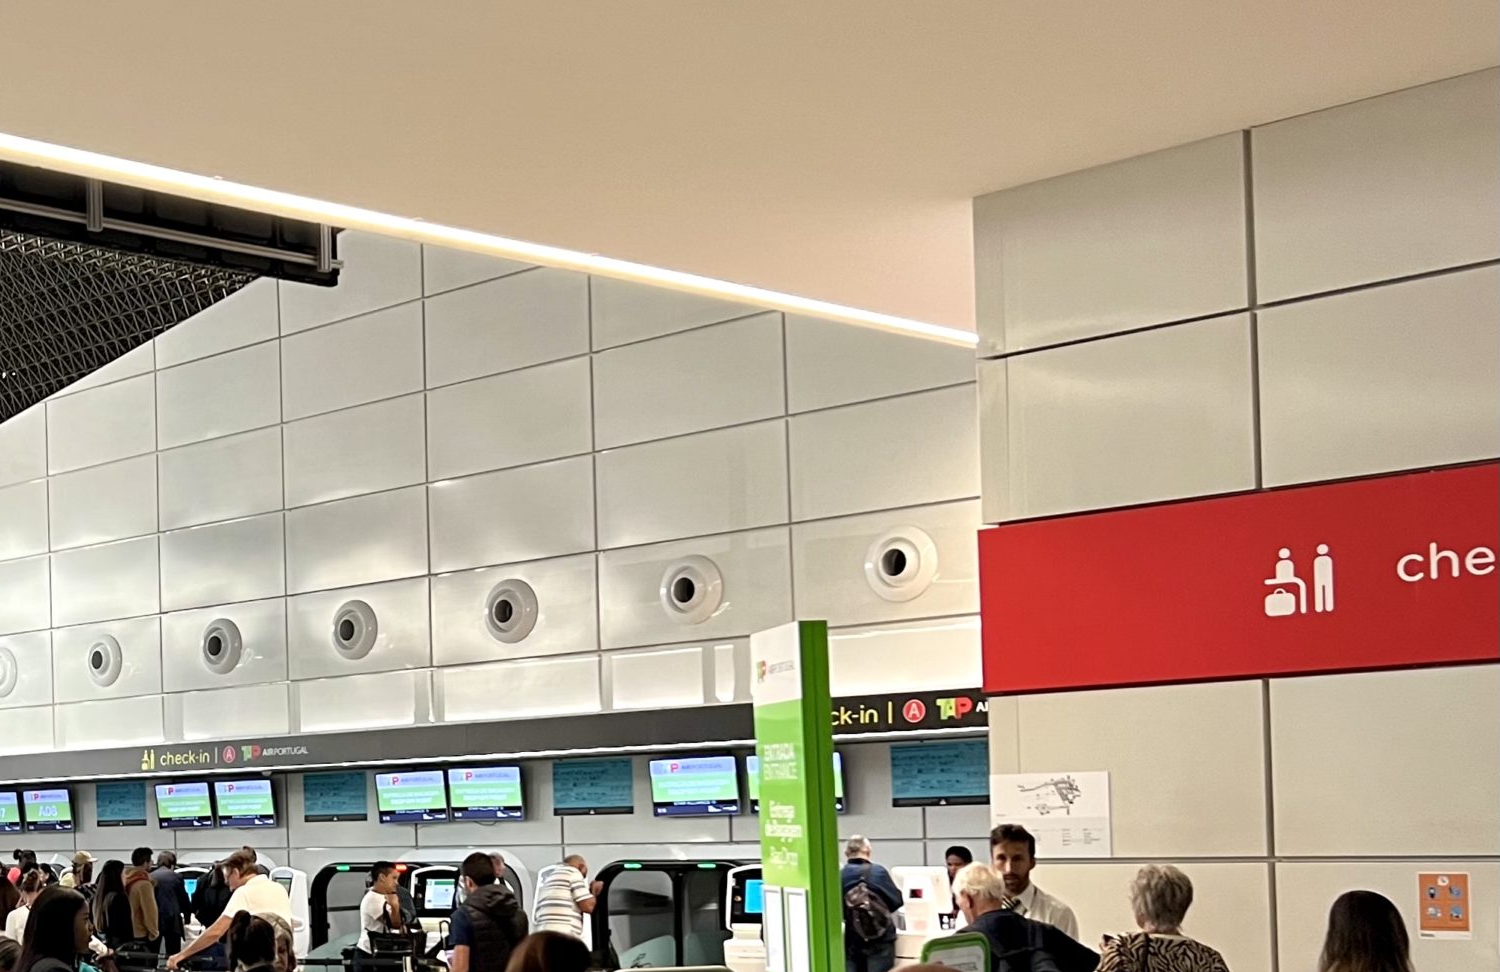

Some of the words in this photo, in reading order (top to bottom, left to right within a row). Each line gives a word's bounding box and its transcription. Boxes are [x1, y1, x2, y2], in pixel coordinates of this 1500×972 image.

[1396, 542, 1496, 583] che
[831, 705, 879, 726] ck-in
[936, 696, 973, 721] TAP
[160, 749, 210, 766] check-in
